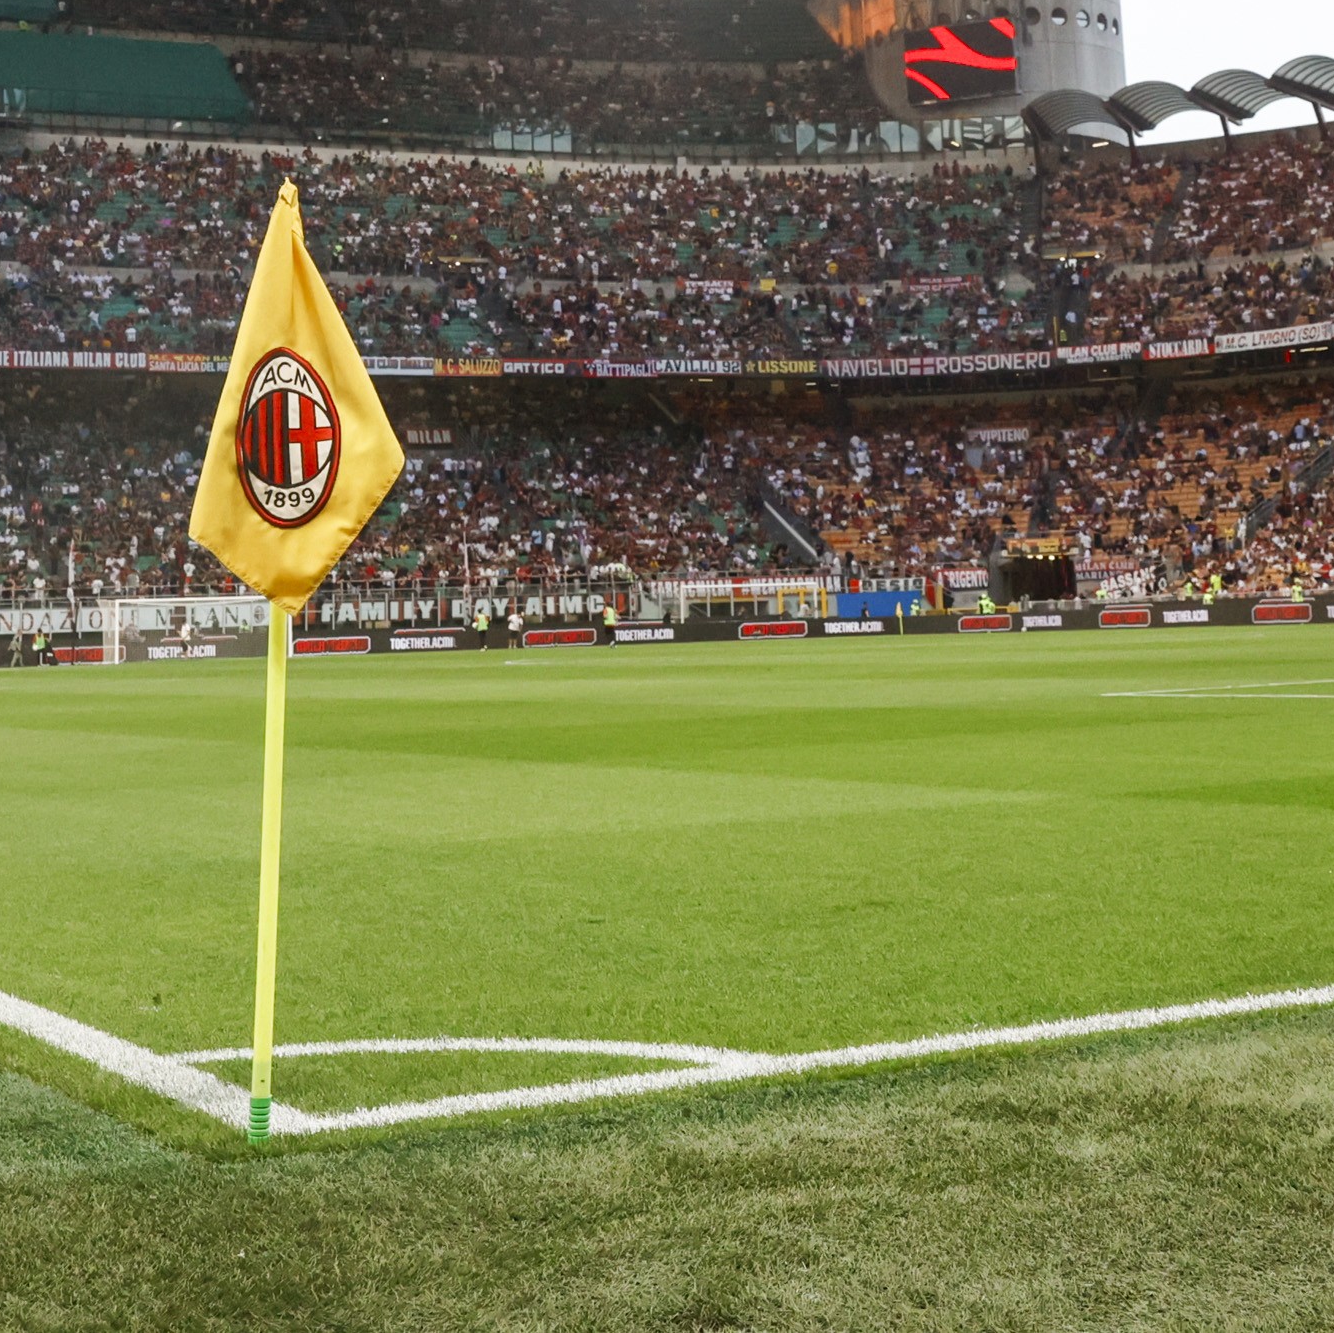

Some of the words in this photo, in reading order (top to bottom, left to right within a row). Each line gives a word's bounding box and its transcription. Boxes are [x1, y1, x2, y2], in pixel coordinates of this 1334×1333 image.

[14, 350, 69, 367] ITALIANA
[73, 352, 111, 368] MILAN
[115, 353, 146, 368] CLUB
[149, 361, 175, 371] SANTA
[177, 362, 200, 372] LUCIA
[758, 360, 817, 373] LISSONE
[827, 359, 908, 378] NAVIGLIO
[935, 351, 1051, 374] ROSSONERO
[259, 362, 314, 394] ACM
[596, 363, 652, 377] BATTIPAGLI
[264, 486, 315, 508] 1899
[938, 570, 989, 588] ARIGENTO
[156, 606, 240, 626] MLAN
[321, 600, 435, 623] FAMILY
